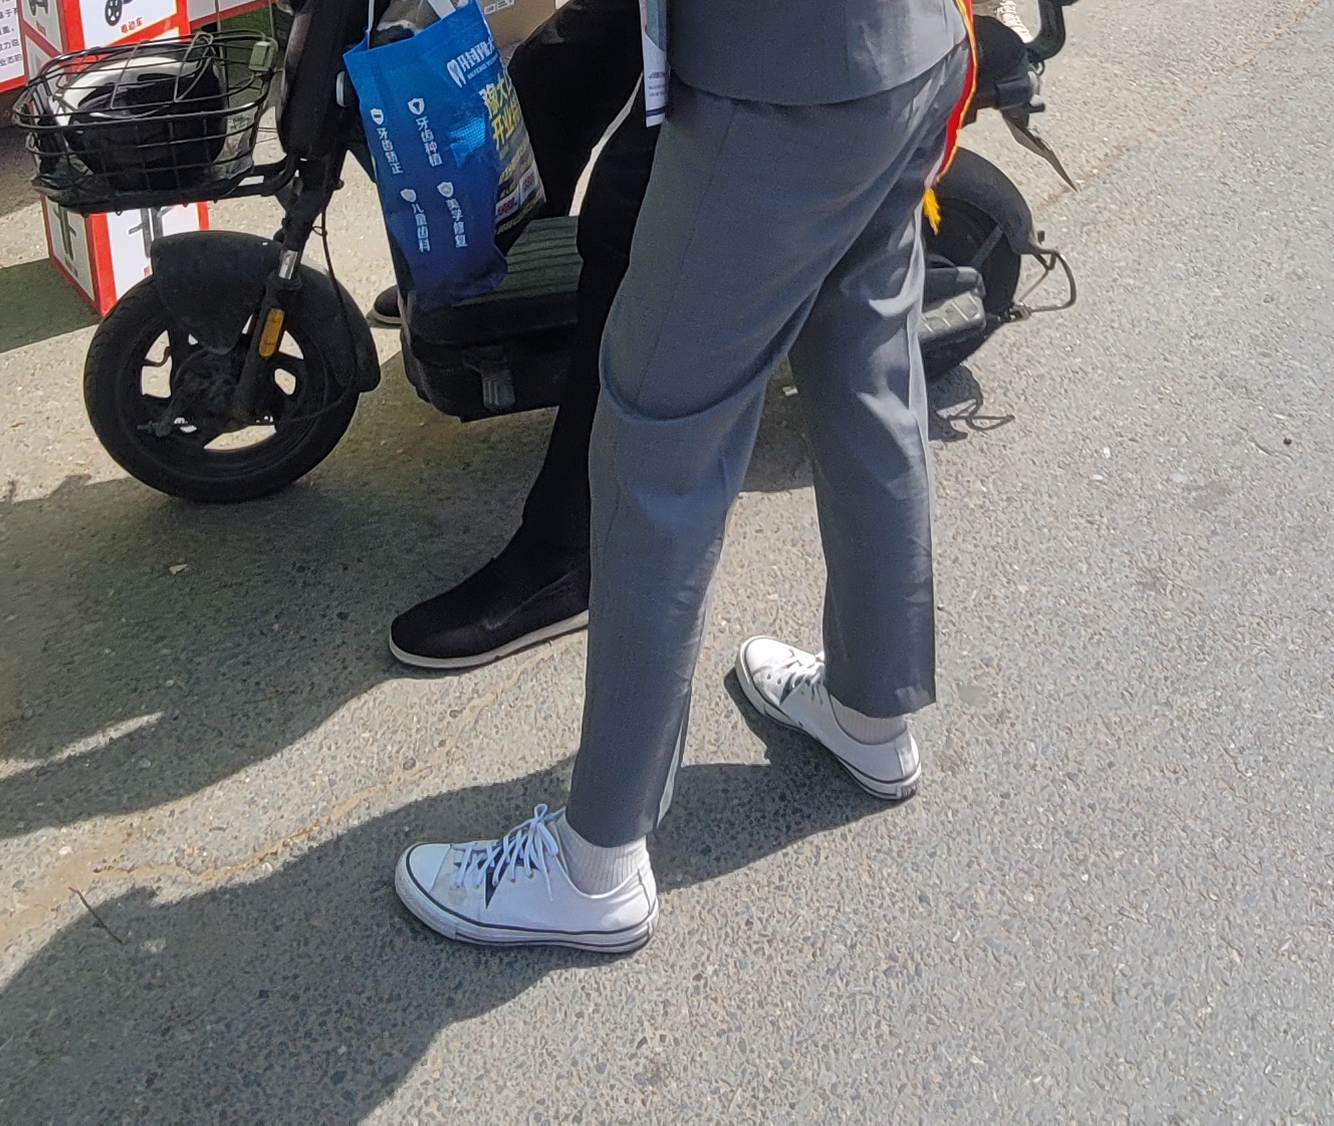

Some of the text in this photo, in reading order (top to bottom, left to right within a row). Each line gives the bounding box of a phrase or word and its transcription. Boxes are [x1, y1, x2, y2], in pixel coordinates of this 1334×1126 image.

[376, 127, 404, 175] 牙齿矫正
[416, 116, 444, 168] 牙齿种植
[411, 203, 432, 253] 儿童齿科
[445, 199, 468, 248] 美学修复
